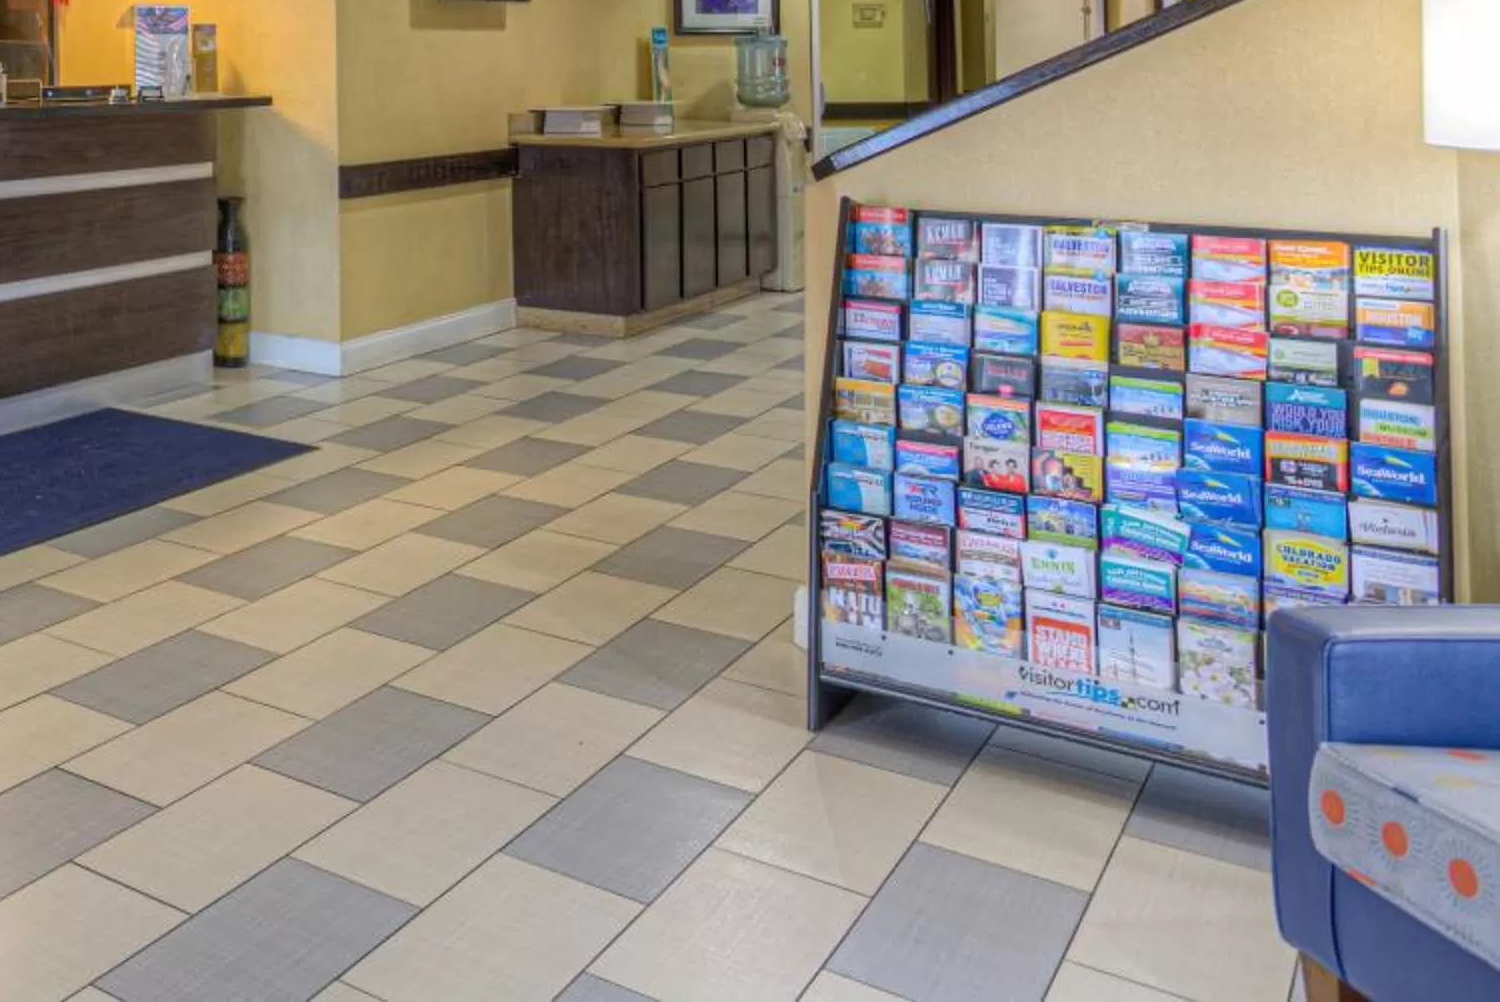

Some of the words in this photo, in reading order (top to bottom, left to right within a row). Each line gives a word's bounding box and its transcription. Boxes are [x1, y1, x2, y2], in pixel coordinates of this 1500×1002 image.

[1358, 251, 1430, 266] VISITOR
[1190, 441, 1252, 459] SeaWorld
[1358, 465, 1427, 484] SeaWorld
[1191, 541, 1253, 563] SeaWorld
[1017, 665, 1181, 716] visitortips.com
